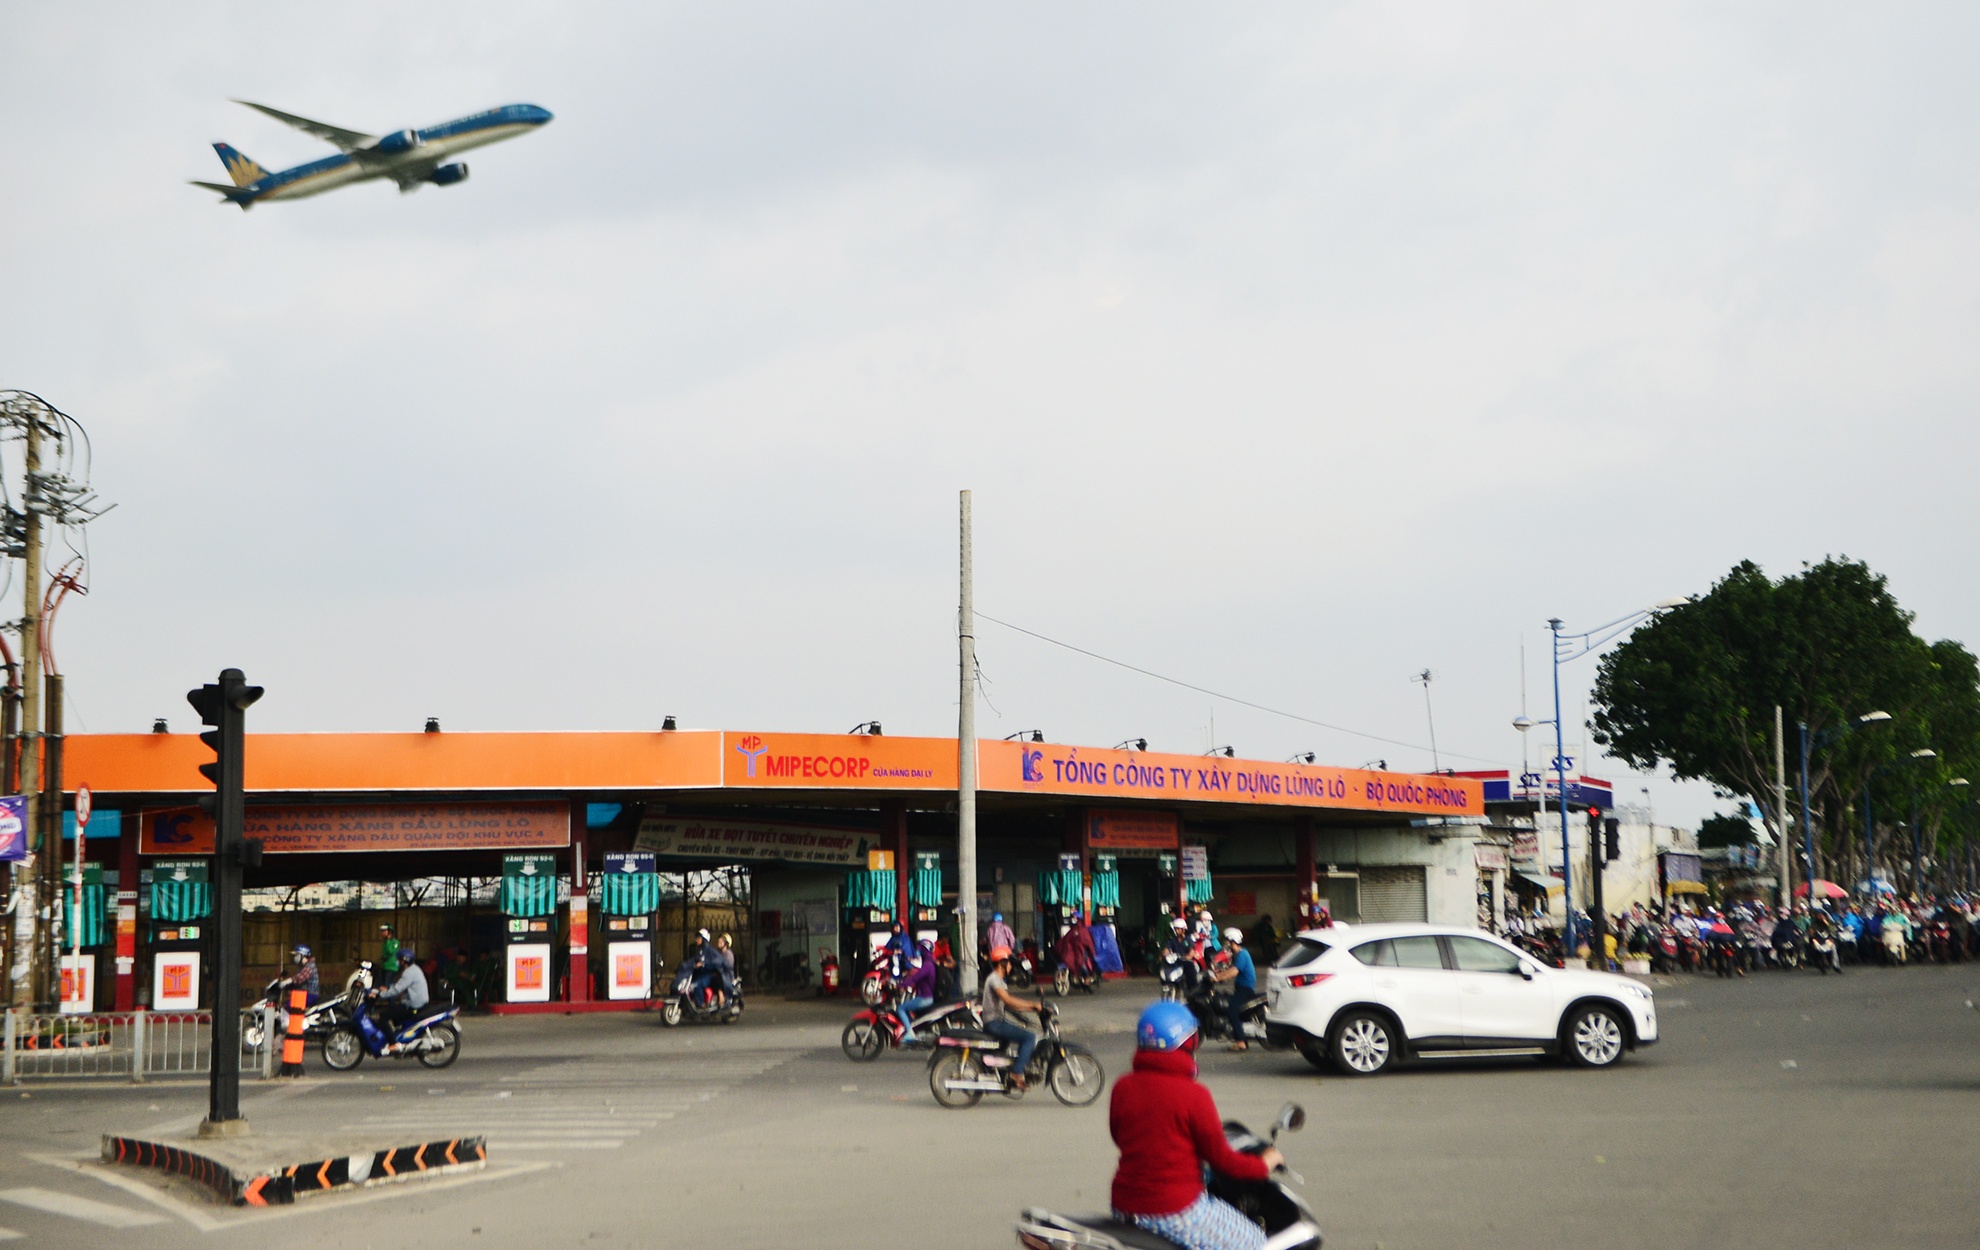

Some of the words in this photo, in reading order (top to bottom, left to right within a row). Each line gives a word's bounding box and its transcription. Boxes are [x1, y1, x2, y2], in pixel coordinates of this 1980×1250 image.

[766, 755, 870, 778] MIPECORP
[890, 767, 910, 778] HÀNG
[1053, 747, 1107, 785] TỔNG
[1113, 758, 1165, 788] CÔNG
[1170, 768, 1193, 790] TY
[1197, 765, 1232, 792] XÂY
[1237, 771, 1281, 799] DỰNG
[1366, 777, 1385, 807] BỘ
[1387, 778, 1424, 805] QUỐC
[1427, 782, 1468, 808] PHÒNG
[306, 834, 322, 842] TY
[708, 827, 722, 840] XE
[724, 828, 745, 843] BỌT
